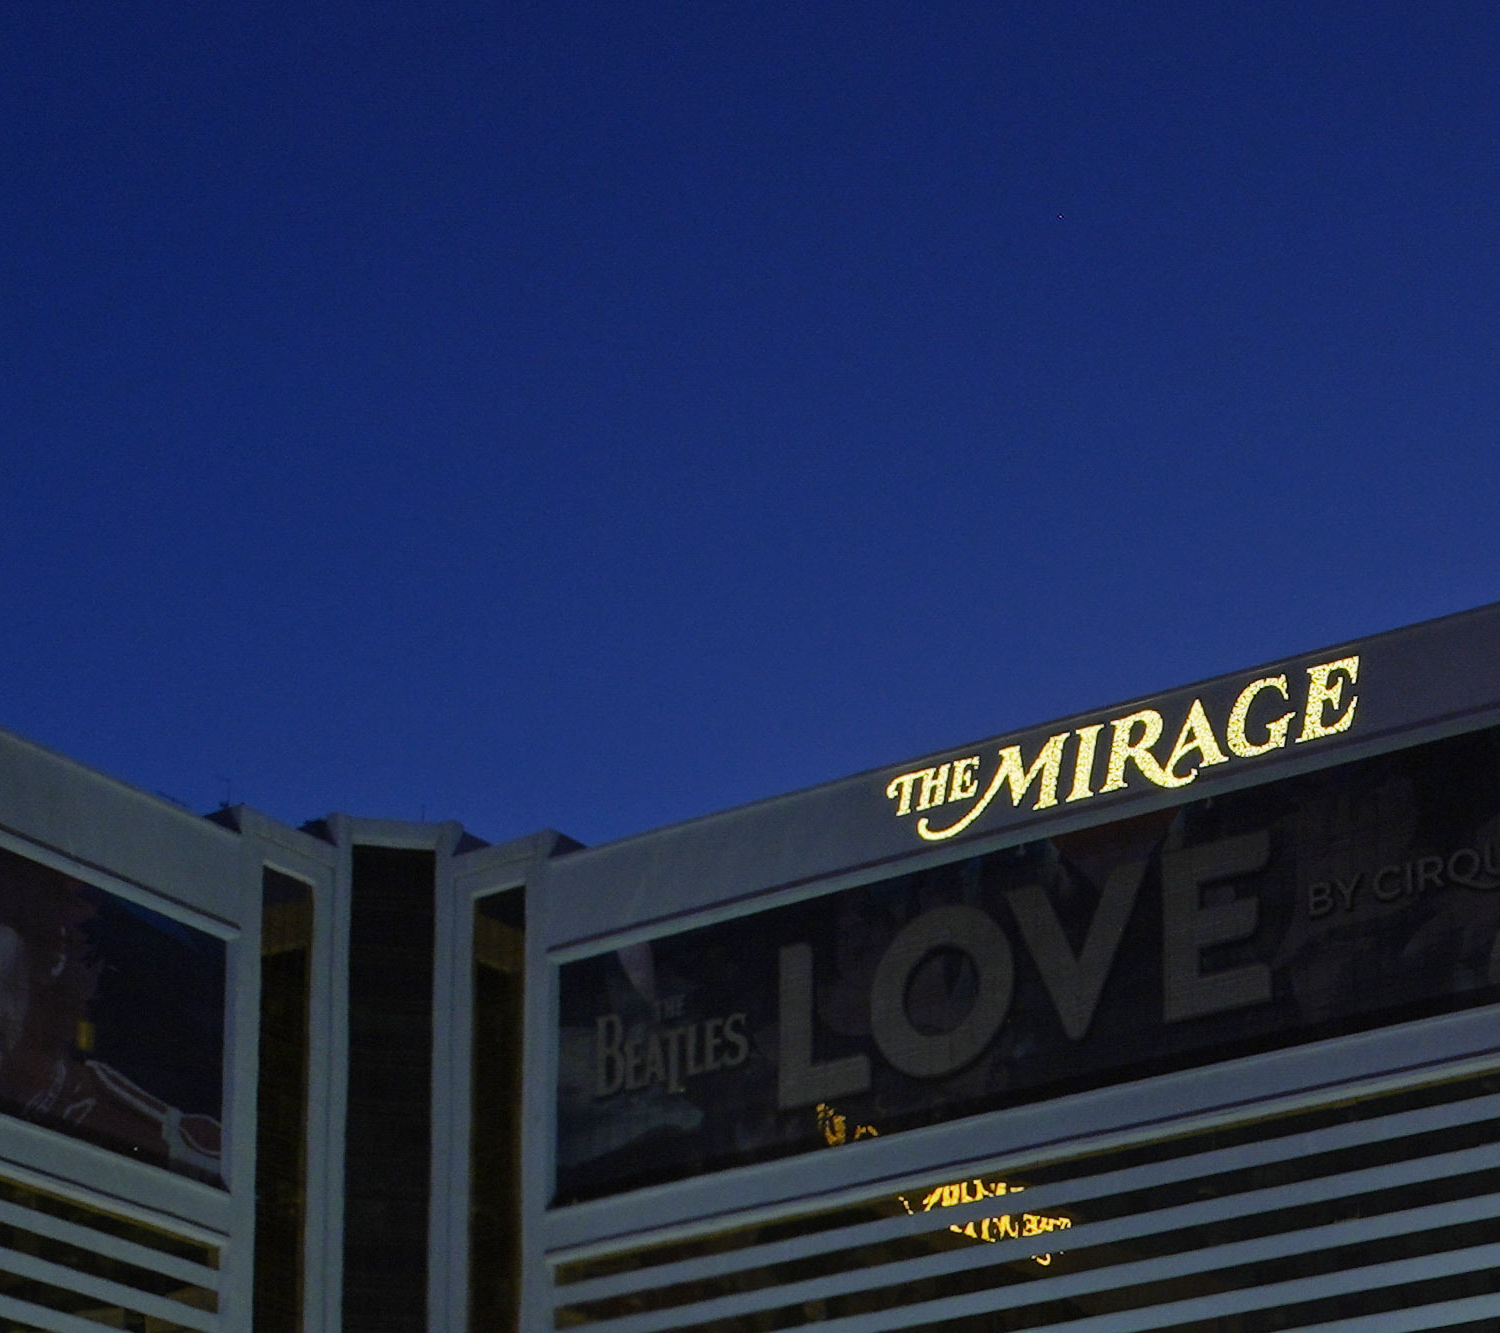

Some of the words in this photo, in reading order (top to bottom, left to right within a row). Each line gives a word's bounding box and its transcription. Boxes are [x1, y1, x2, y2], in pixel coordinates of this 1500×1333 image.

[886, 755, 980, 817] THE
[917, 655, 1360, 841] MIRAGE
[1307, 877, 1362, 919] BY
[778, 828, 1274, 1109] LOVE
[595, 1012, 749, 1098] BEATLES
